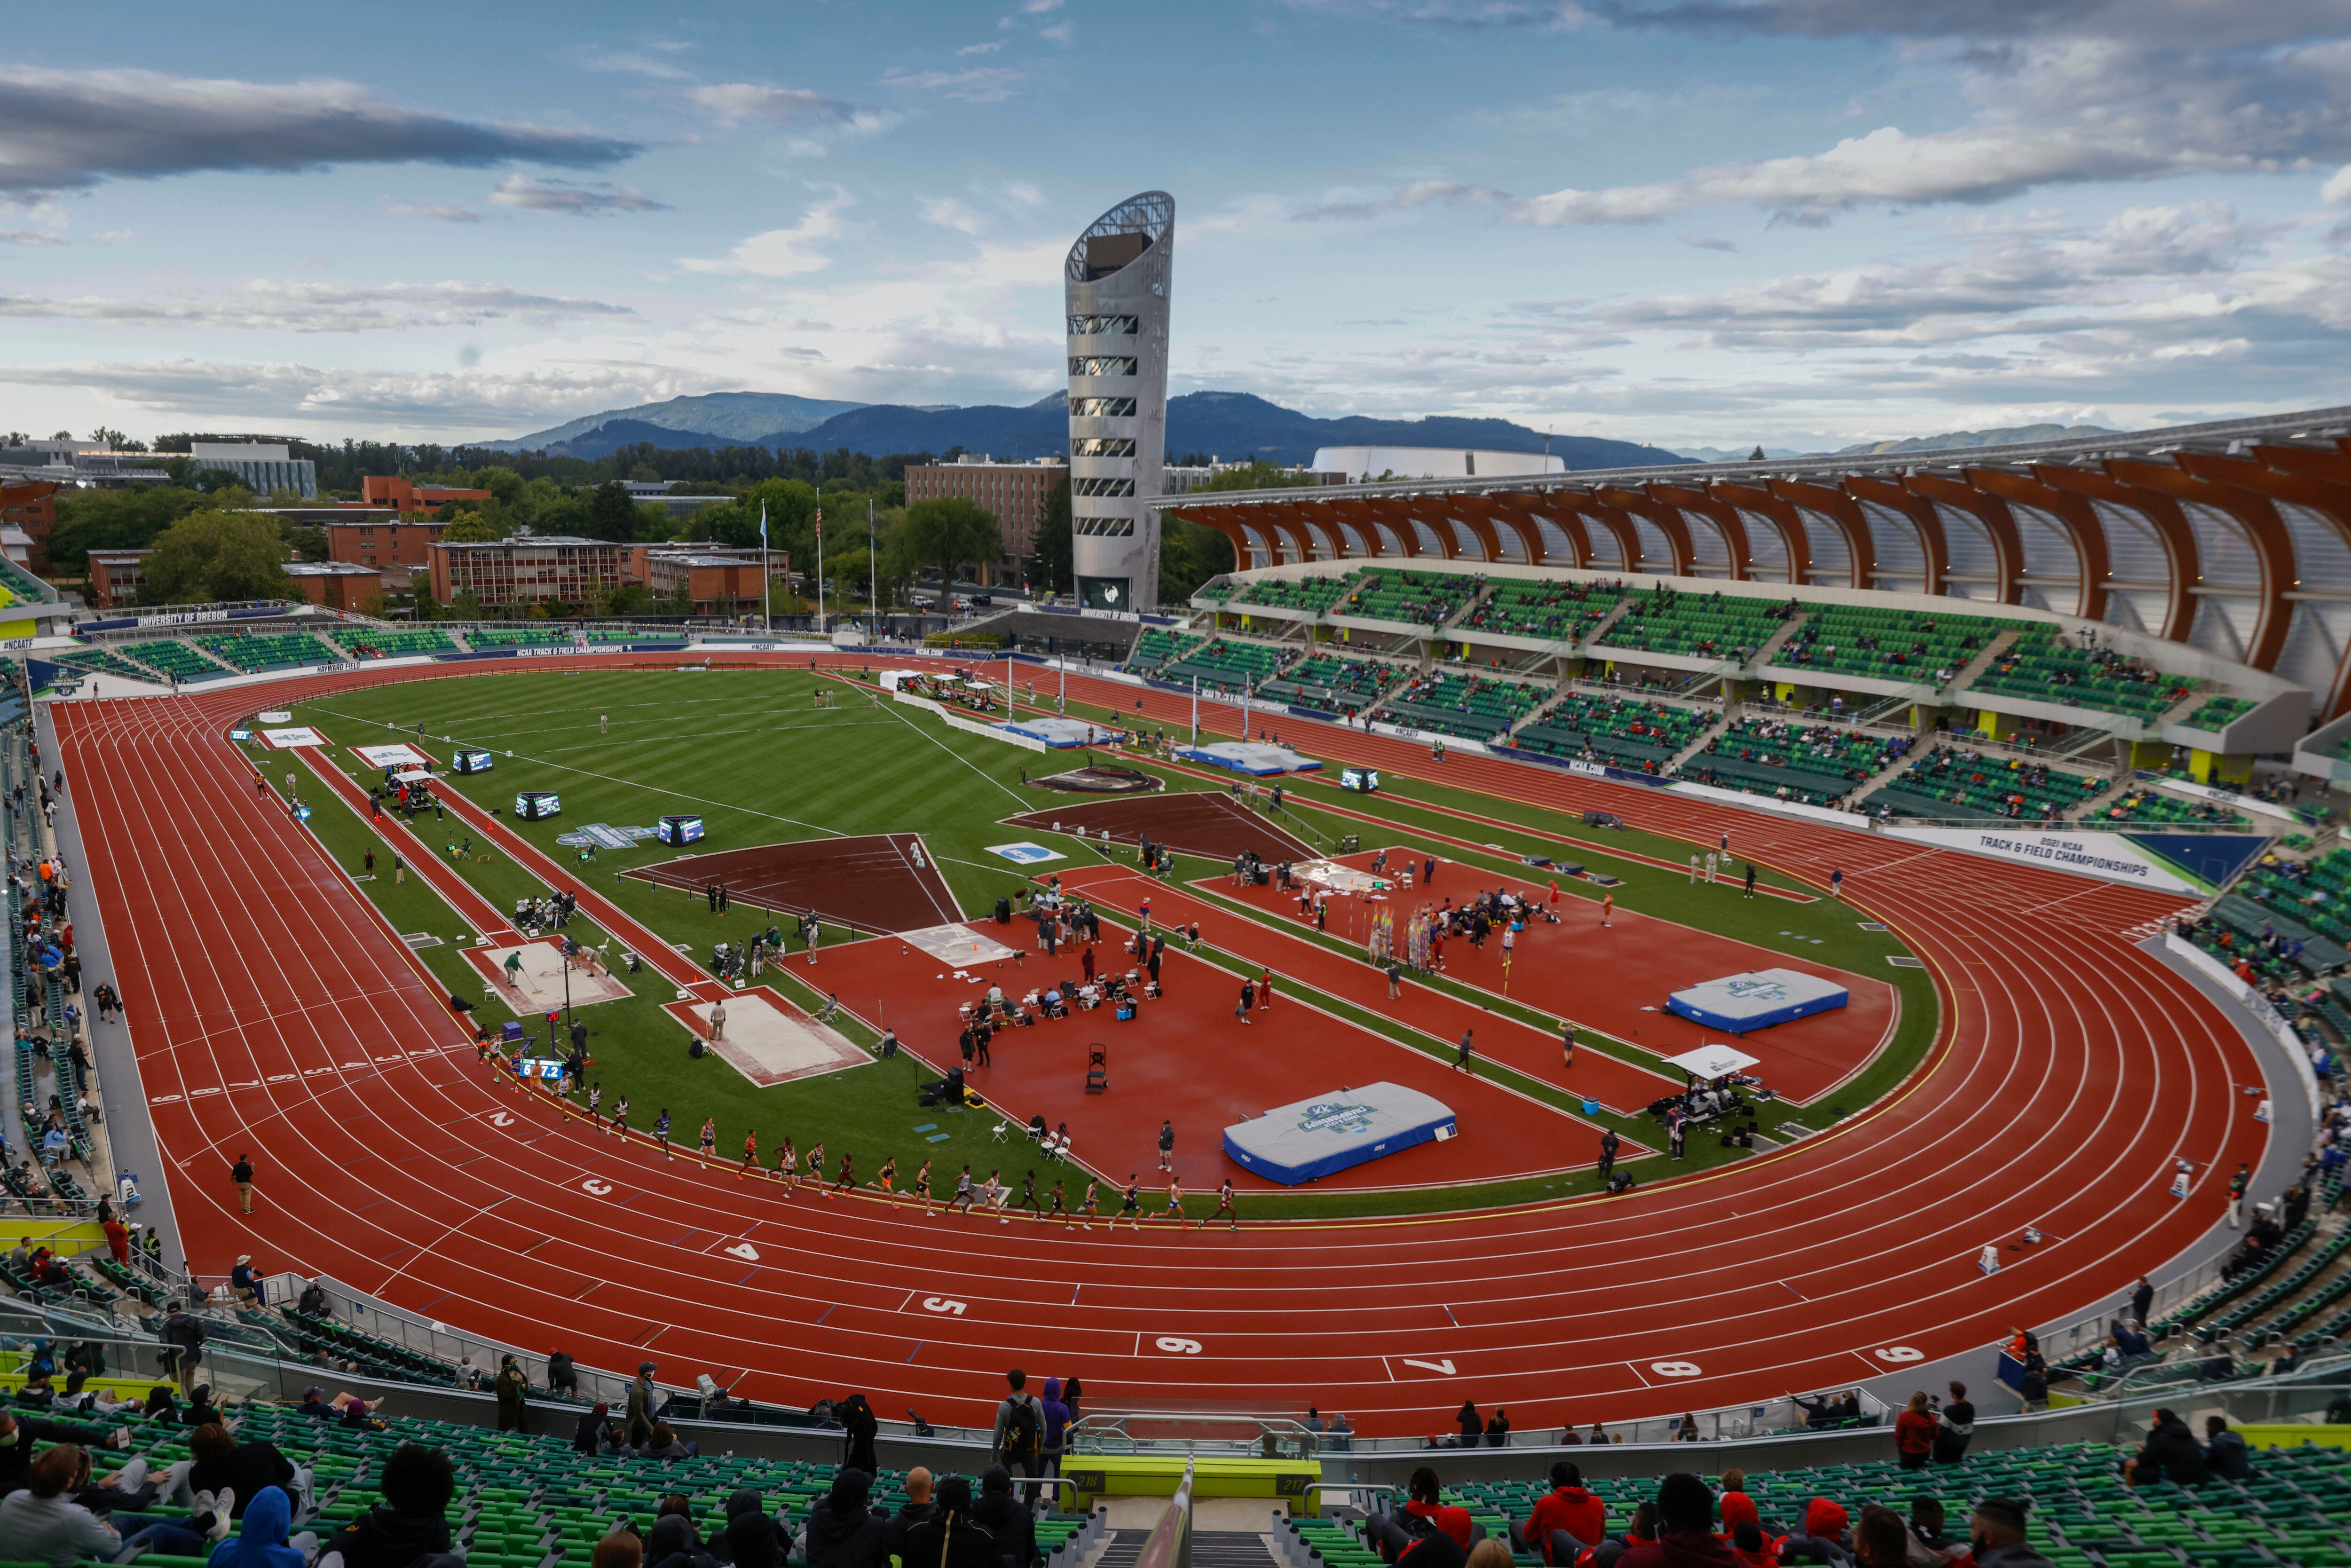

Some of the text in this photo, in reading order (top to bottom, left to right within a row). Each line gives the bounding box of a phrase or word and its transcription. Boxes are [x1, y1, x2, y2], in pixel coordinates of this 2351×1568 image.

[138, 611, 228, 626] UNIVERSITY OF OREGON
[1081, 608, 1112, 618] UNIVERSITY
[1120, 612, 1139, 622] OREGON
[4, 639, 33, 650] #NCAATF
[317, 662, 360, 673] HAYWARD FIELD
[2060, 841, 2083, 851] NCAA
[1980, 836, 2148, 876] TRACK & FIELD CHAMPIONSHIPS
[549, 1012, 559, 1021] 20
[304, 1066, 332, 1075] 5
[191, 1087, 221, 1095] 8
[151, 1094, 182, 1103] 9
[488, 1111, 515, 1127] 2
[126, 1187, 134, 1198] 2
[582, 1179, 612, 1195] 3
[724, 1243, 759, 1261] 4
[923, 1297, 967, 1315] 5
[1155, 1337, 1202, 1354] 6
[1874, 1346, 1925, 1363] 9
[1403, 1359, 1457, 1375] 7
[1651, 1361, 1702, 1377] 8
[1077, 1475, 1097, 1487] 218
[1284, 1479, 1304, 1490] 217
